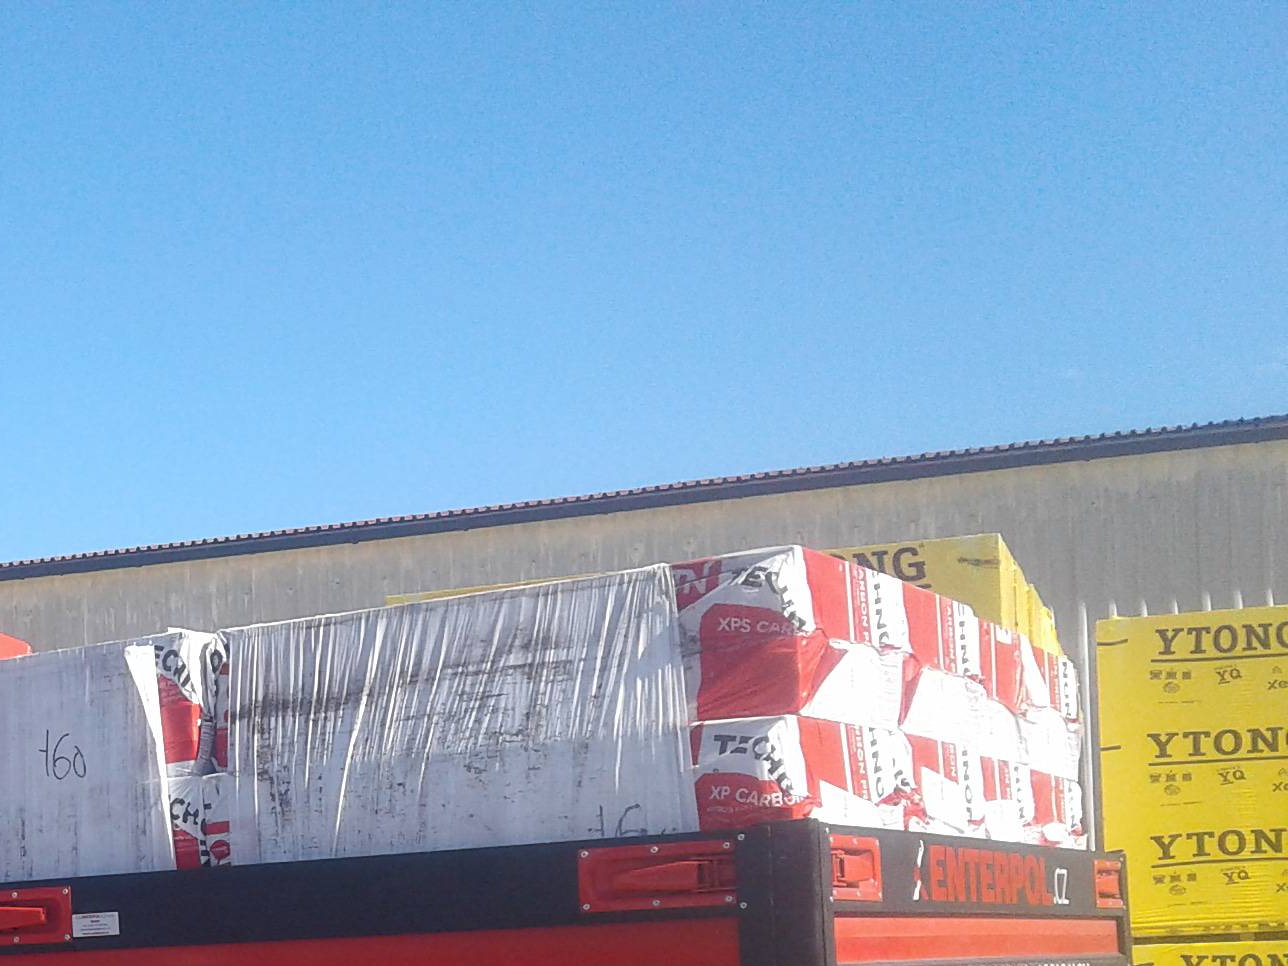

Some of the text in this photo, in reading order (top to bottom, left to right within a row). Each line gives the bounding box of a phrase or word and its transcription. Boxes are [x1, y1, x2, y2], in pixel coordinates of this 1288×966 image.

[718, 616, 751, 633] XPS
[38, 729, 86, 780] 160
[1147, 727, 1288, 759] YTON
